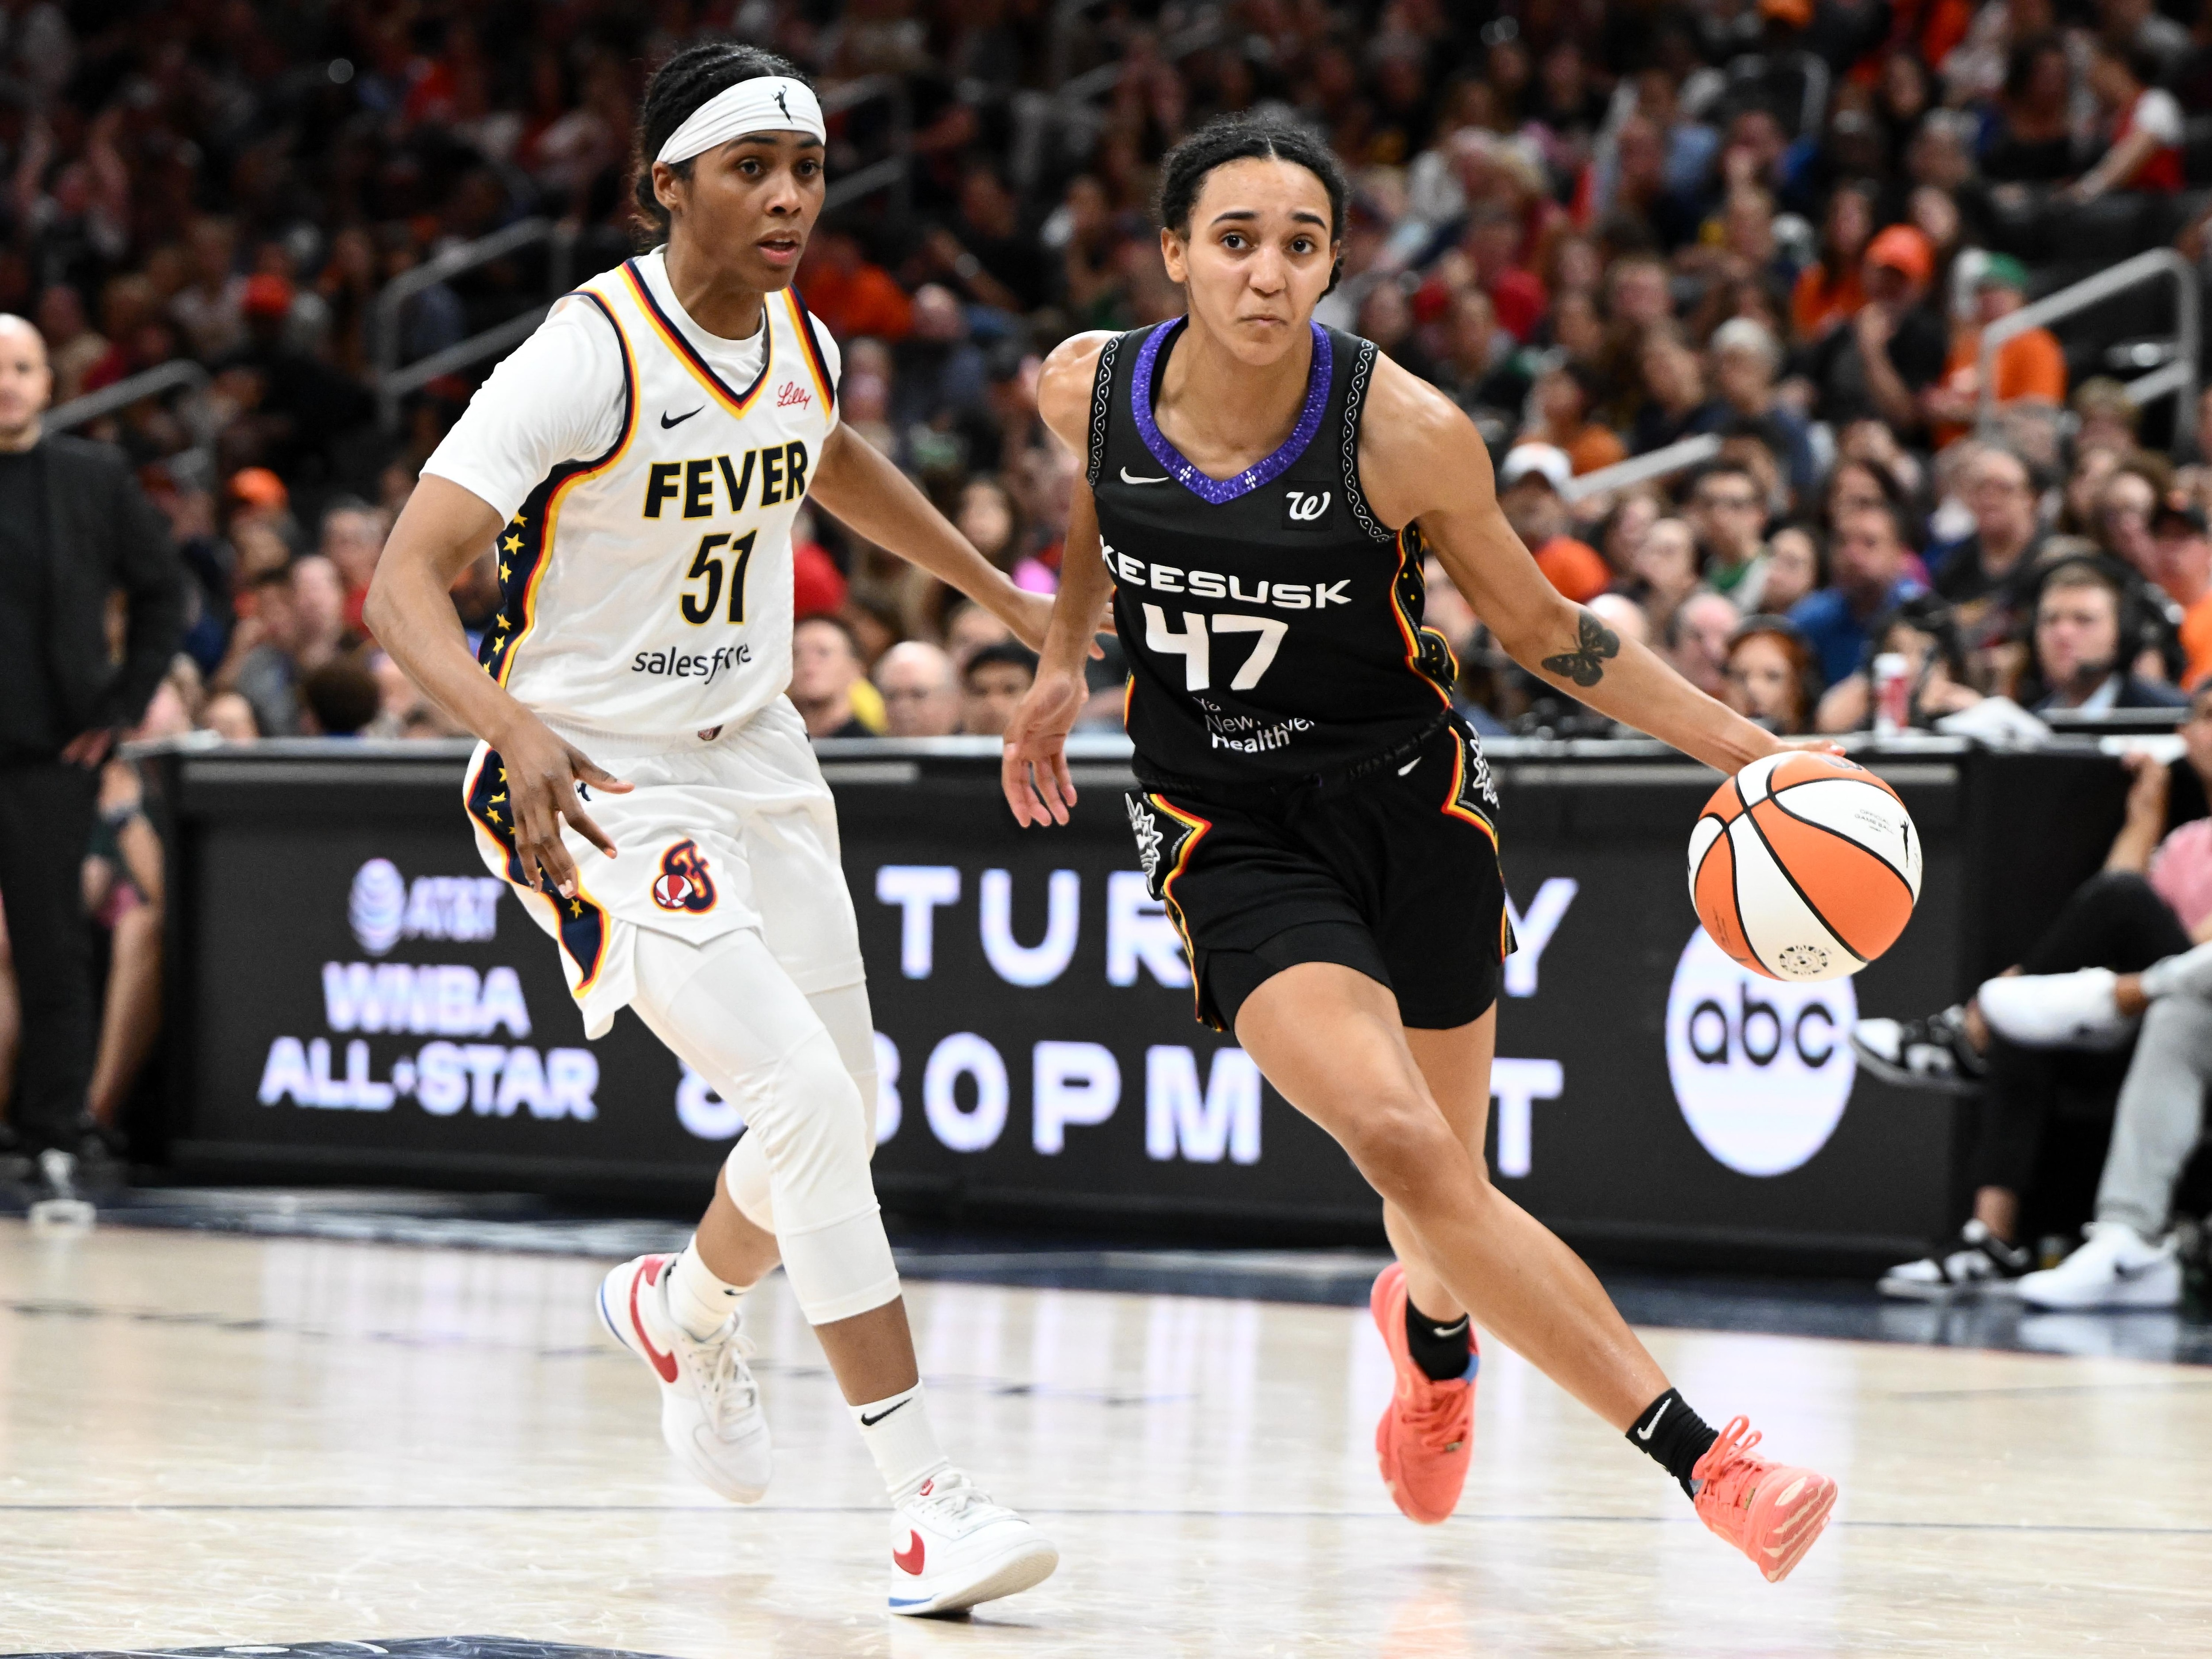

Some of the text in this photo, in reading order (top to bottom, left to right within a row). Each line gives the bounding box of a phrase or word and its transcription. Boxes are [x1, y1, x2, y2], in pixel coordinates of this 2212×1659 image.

[777, 380, 811, 410] Lilly
[642, 440, 808, 520] FEVER
[680, 528, 757, 625] 51
[1099, 534, 1352, 609] KEESUSK
[1142, 603, 1289, 692] 47
[1211, 725, 1290, 753] Health
[1854, 814, 1876, 825] GAME
[1878, 822, 1894, 834] BALL
[322, 962, 531, 1038] WNBA
[1688, 980, 1835, 1069] abc
